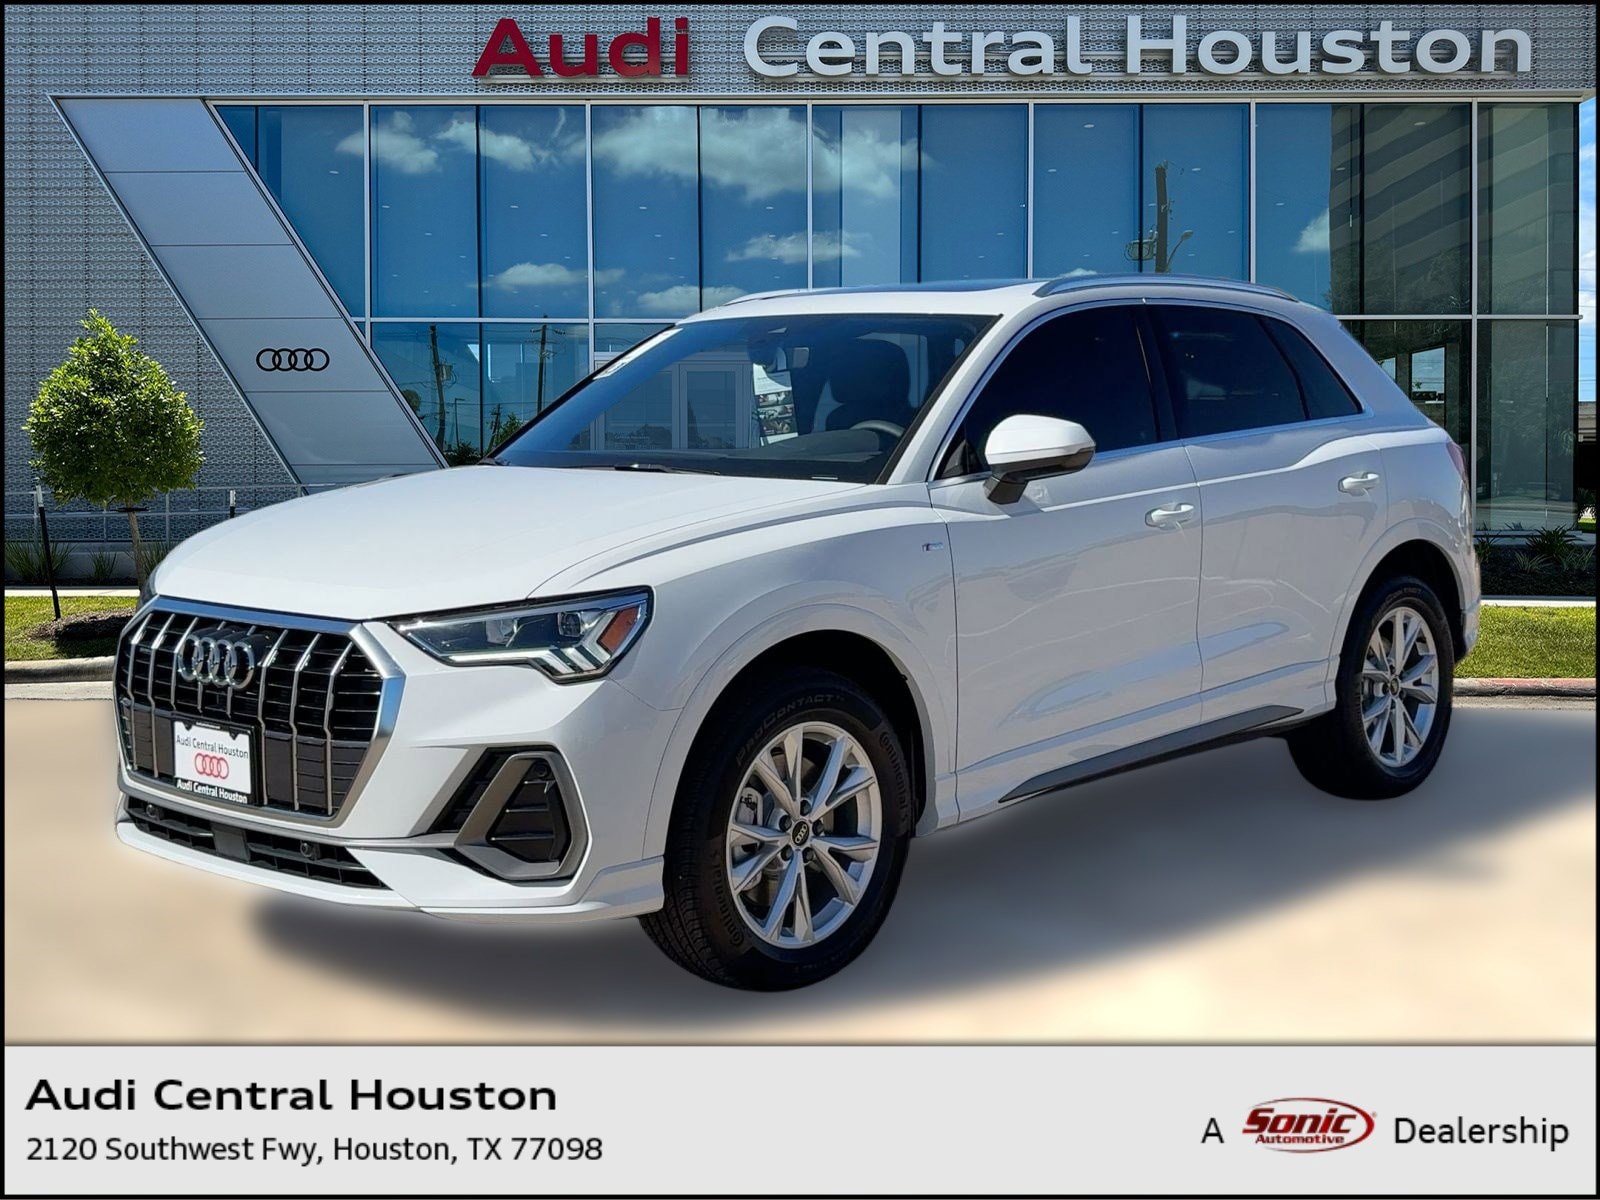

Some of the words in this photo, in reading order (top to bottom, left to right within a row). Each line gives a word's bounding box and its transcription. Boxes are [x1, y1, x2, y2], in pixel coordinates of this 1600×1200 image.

[472, 17, 690, 78] Audi
[743, 15, 1093, 77] Central
[1126, 15, 1532, 75] Houston
[176, 735, 191, 747] Audi
[192, 737, 217, 753] Central
[218, 743, 249, 759] Houston
[177, 779, 193, 792] Audi
[193, 782, 218, 798] Central
[218, 787, 248, 804] Houston
